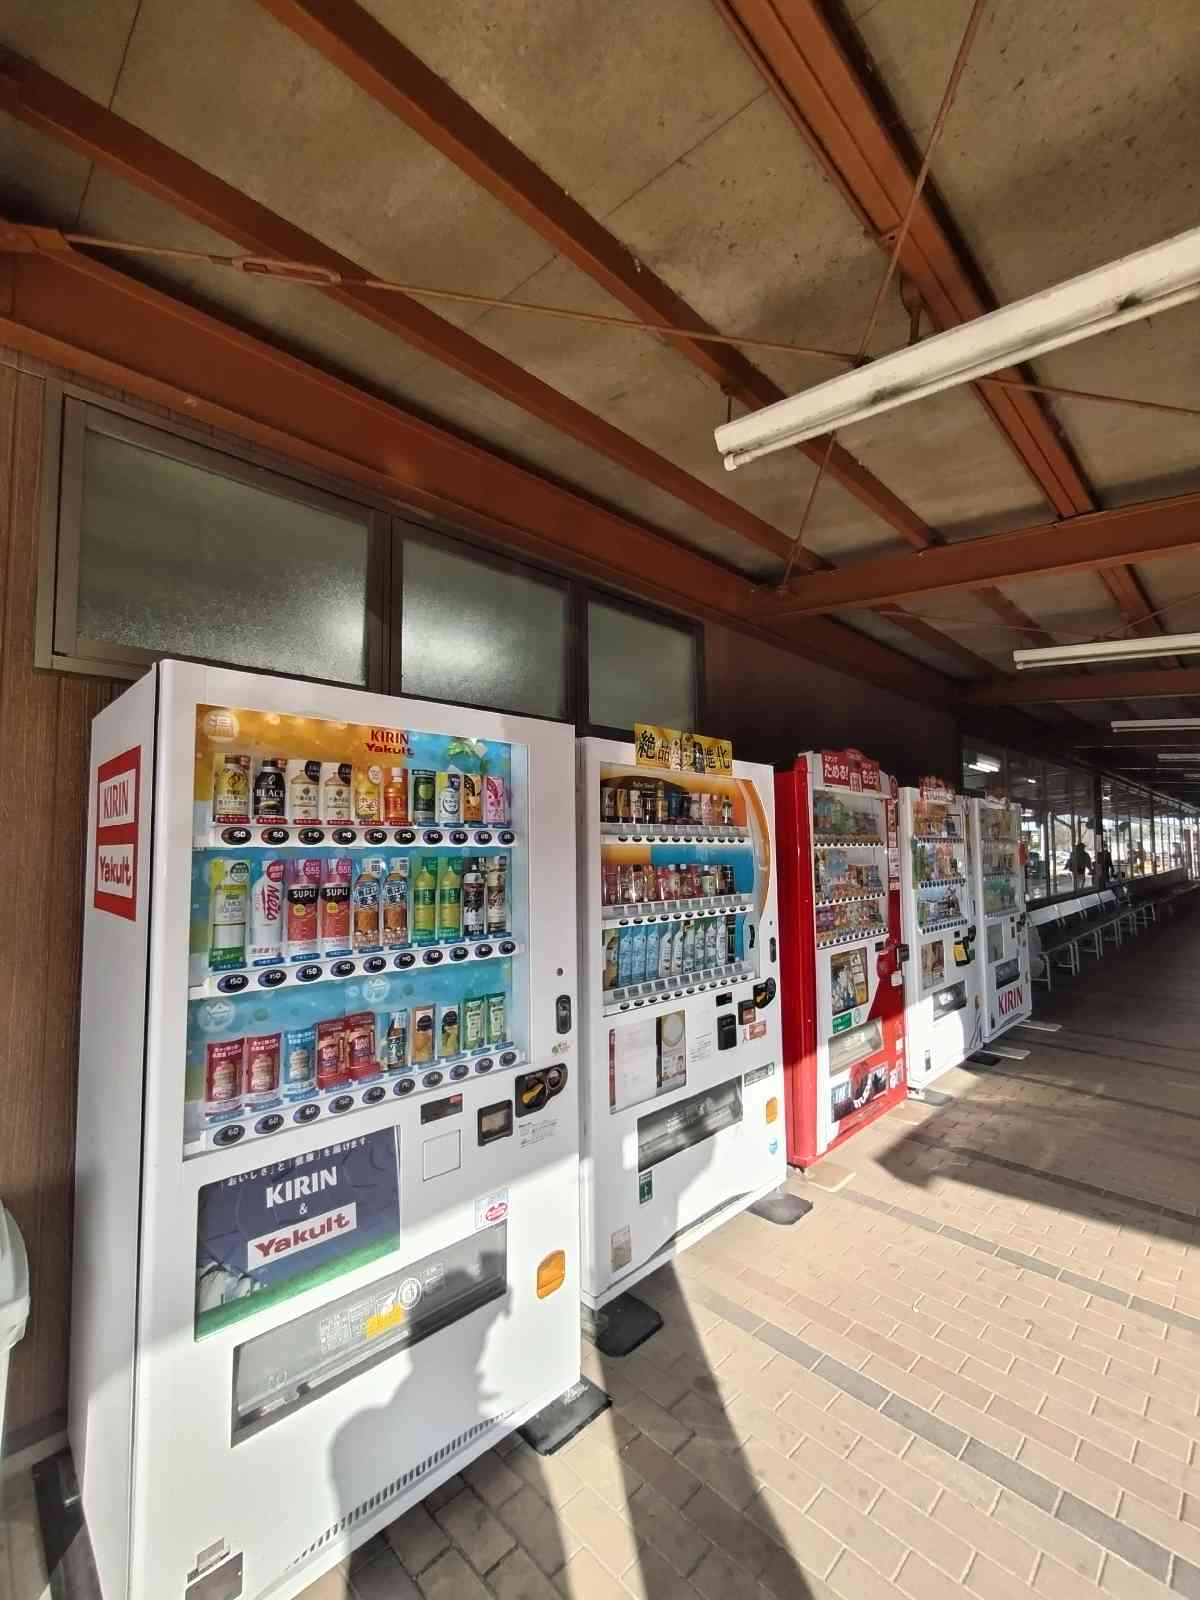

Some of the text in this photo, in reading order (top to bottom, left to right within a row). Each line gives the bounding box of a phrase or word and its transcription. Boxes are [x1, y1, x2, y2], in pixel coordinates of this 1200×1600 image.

[371, 729, 409, 745] KIRIN
[365, 743, 415, 756] Yakult
[103, 780, 129, 819] KIRIN
[256, 787, 285, 799] BLACK
[100, 856, 132, 887] Yakult
[265, 884, 282, 921] Mets
[293, 888, 316, 899] SUPLI
[326, 887, 348, 898] SUPLI
[998, 985, 1024, 1018] KIRIN
[266, 1165, 338, 1208] KIRIN
[299, 1202, 308, 1216] &
[255, 1212, 351, 1258] Yakult
